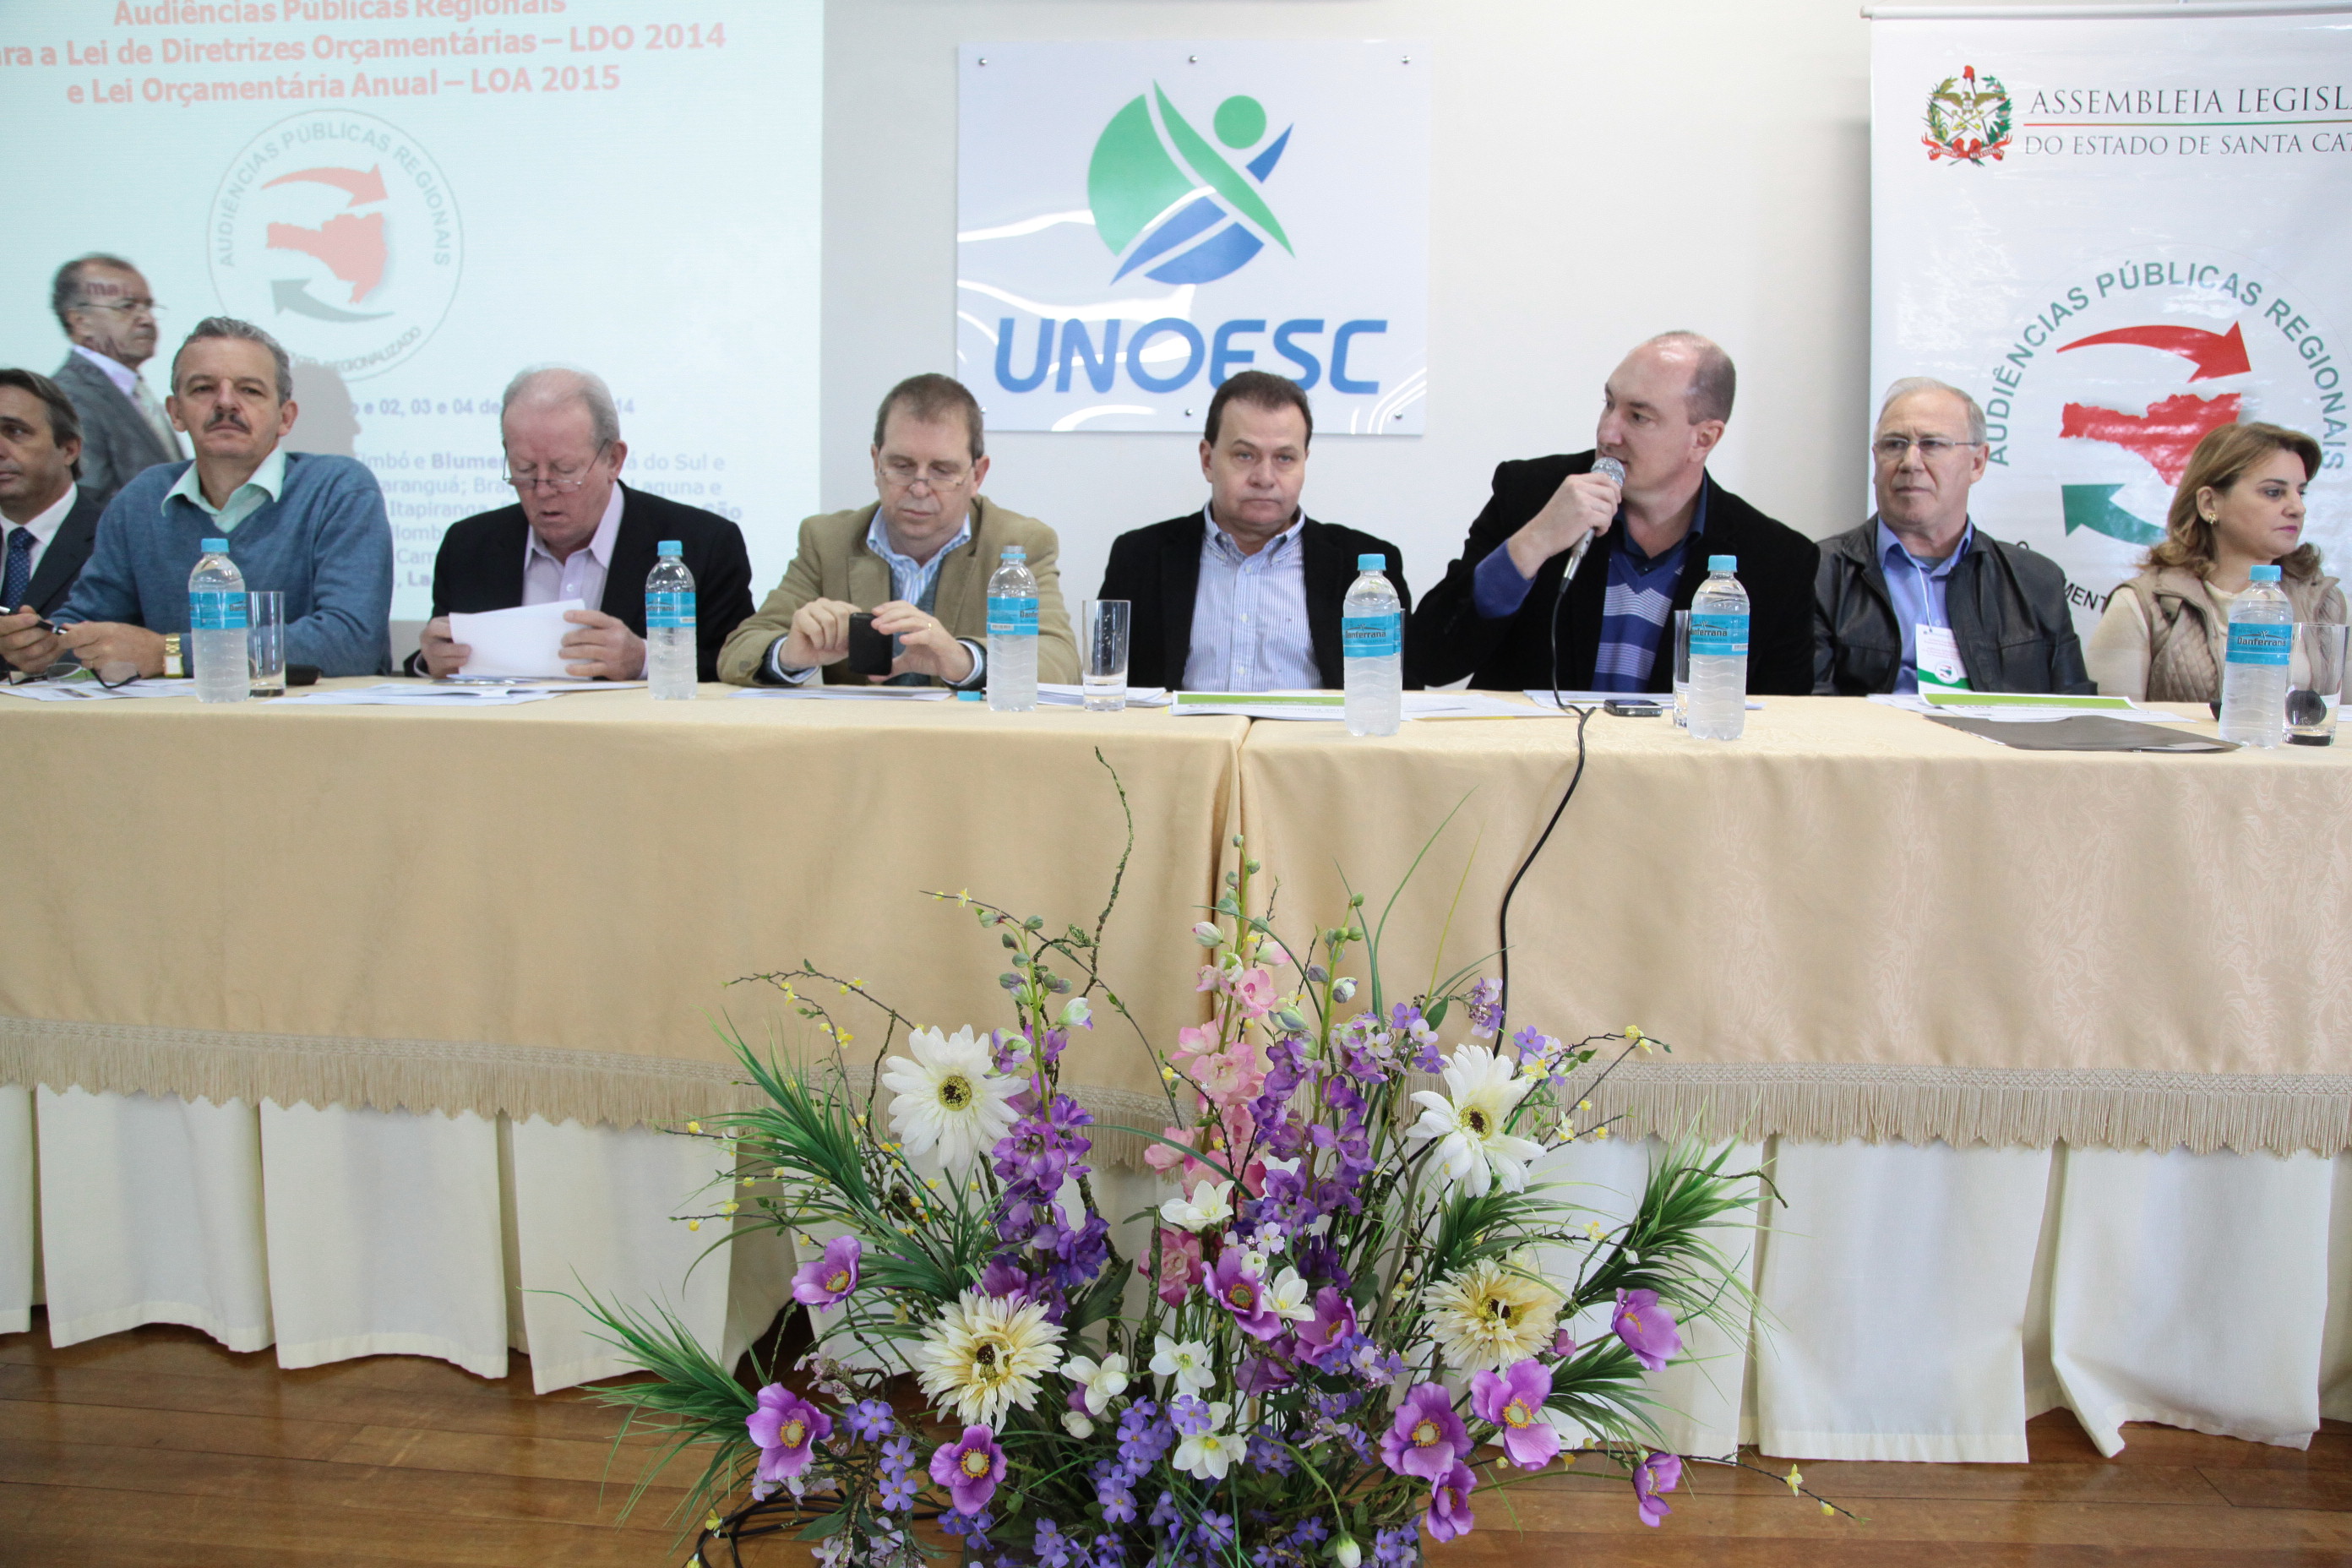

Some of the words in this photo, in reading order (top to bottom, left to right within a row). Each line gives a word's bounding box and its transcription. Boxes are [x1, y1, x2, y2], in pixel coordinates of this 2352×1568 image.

[113, 0, 277, 26] Audiências
[416, 0, 567, 22] Regionais
[0, 45, 33, 67] ra
[41, 45, 57, 66] a
[67, 40, 108, 65] Lei
[117, 38, 153, 64] de
[161, 37, 306, 64] Diretrizes
[313, 28, 537, 64] Orçamentárias
[570, 24, 634, 52] LDO
[645, 22, 727, 51] 2014
[67, 83, 84, 103] e
[93, 79, 133, 103] Lei
[142, 72, 346, 108] Orçamentária
[351, 68, 438, 98] Anual
[471, 68, 532, 95] LOA
[542, 64, 621, 92] 2015
[2029, 89, 2224, 114] ASSEMBLEIA
[2025, 135, 2063, 155] DO
[2073, 135, 2169, 155] ESTADO
[2178, 135, 2210, 155] DE
[2219, 133, 2304, 155] SANTA
[217, 142, 280, 269] AUDIÊNCIAS
[280, 121, 391, 151] PÚBLICAS
[393, 144, 451, 268] REGIONAIS
[994, 316, 1389, 395] UNOESC
[1985, 286, 2090, 466] AUDIÊNCIAS
[2095, 260, 2262, 307] PÚBLICAS
[2263, 297, 2347, 470] REGIONAIS
[643, 451, 670, 471] do
[675, 452, 708, 471] Sul
[712, 456, 726, 471] e
[709, 482, 721, 496] e
